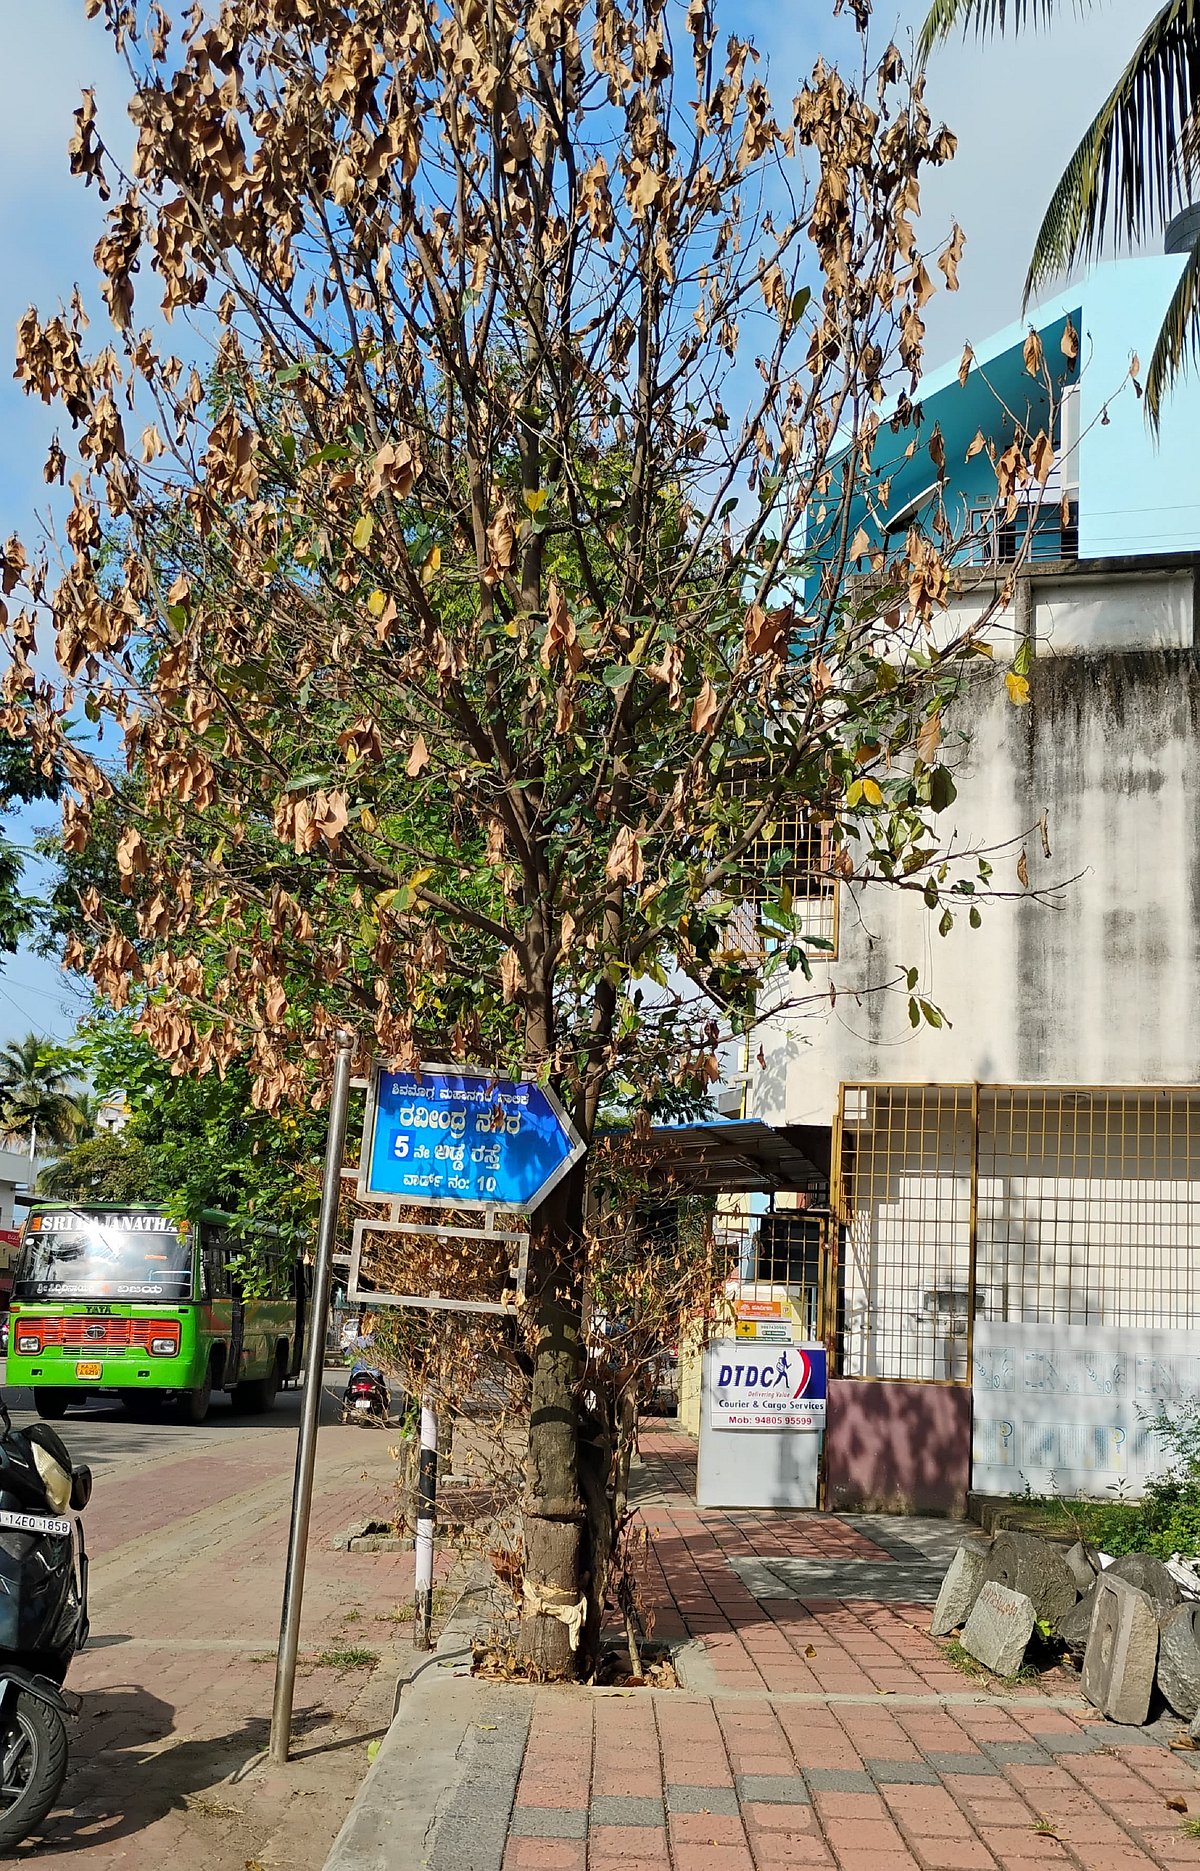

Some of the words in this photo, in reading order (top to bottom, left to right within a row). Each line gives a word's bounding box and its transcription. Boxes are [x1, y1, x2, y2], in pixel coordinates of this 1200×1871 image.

[391, 1083, 435, 1100] ಶಿವಮೊಗ್ಗ
[399, 1103, 468, 1139] ರವೀಂದ್ರ
[394, 1135, 410, 1158] 5
[414, 1146, 430, 1159] ನೇ
[434, 1143, 465, 1171] ಅಡ್ಡ
[471, 1143, 502, 1170] ರಸ್ತೆ
[477, 1176, 497, 1192] 10
[41, 1216, 74, 1232] SRI
[86, 1305, 111, 1313] TATA
[718, 1365, 774, 1388] DTDC
[719, 1400, 750, 1409] Courier
[752, 1400, 759, 1409] &
[762, 1400, 787, 1411] Cargo
[790, 1401, 824, 1410] Services
[728, 1416, 753, 1425] Mob:
[754, 1416, 782, 1425] 94805
[784, 1416, 812, 1426] 95599
[9, 1514, 36, 1528] 14EQ
[43, 1520, 68, 1532] 1858
